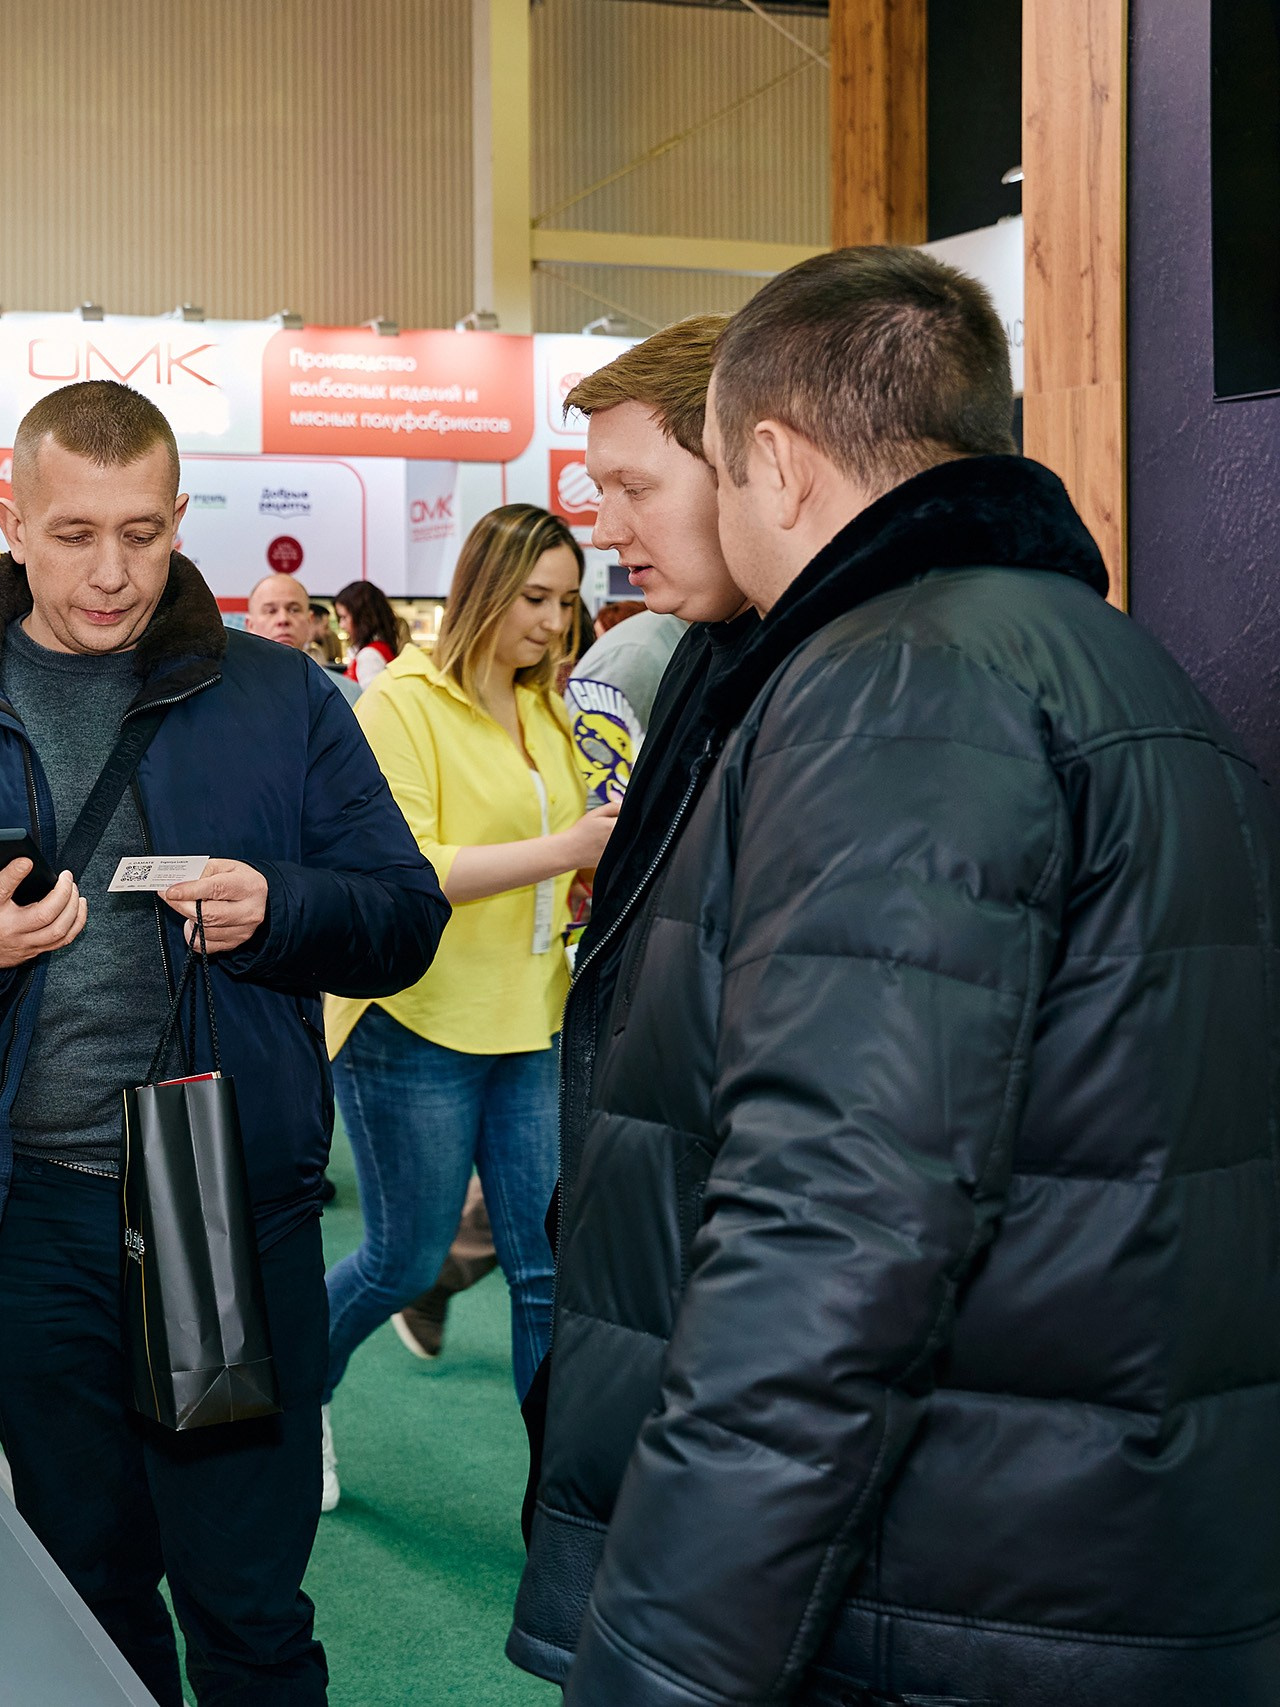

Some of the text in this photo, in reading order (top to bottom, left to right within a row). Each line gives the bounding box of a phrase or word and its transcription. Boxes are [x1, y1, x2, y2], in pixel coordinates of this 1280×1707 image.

[289, 347, 417, 372] Производство
[289, 376, 478, 403] колбасных изделий и
[289, 409, 512, 435] мясных полуфабрикатов
